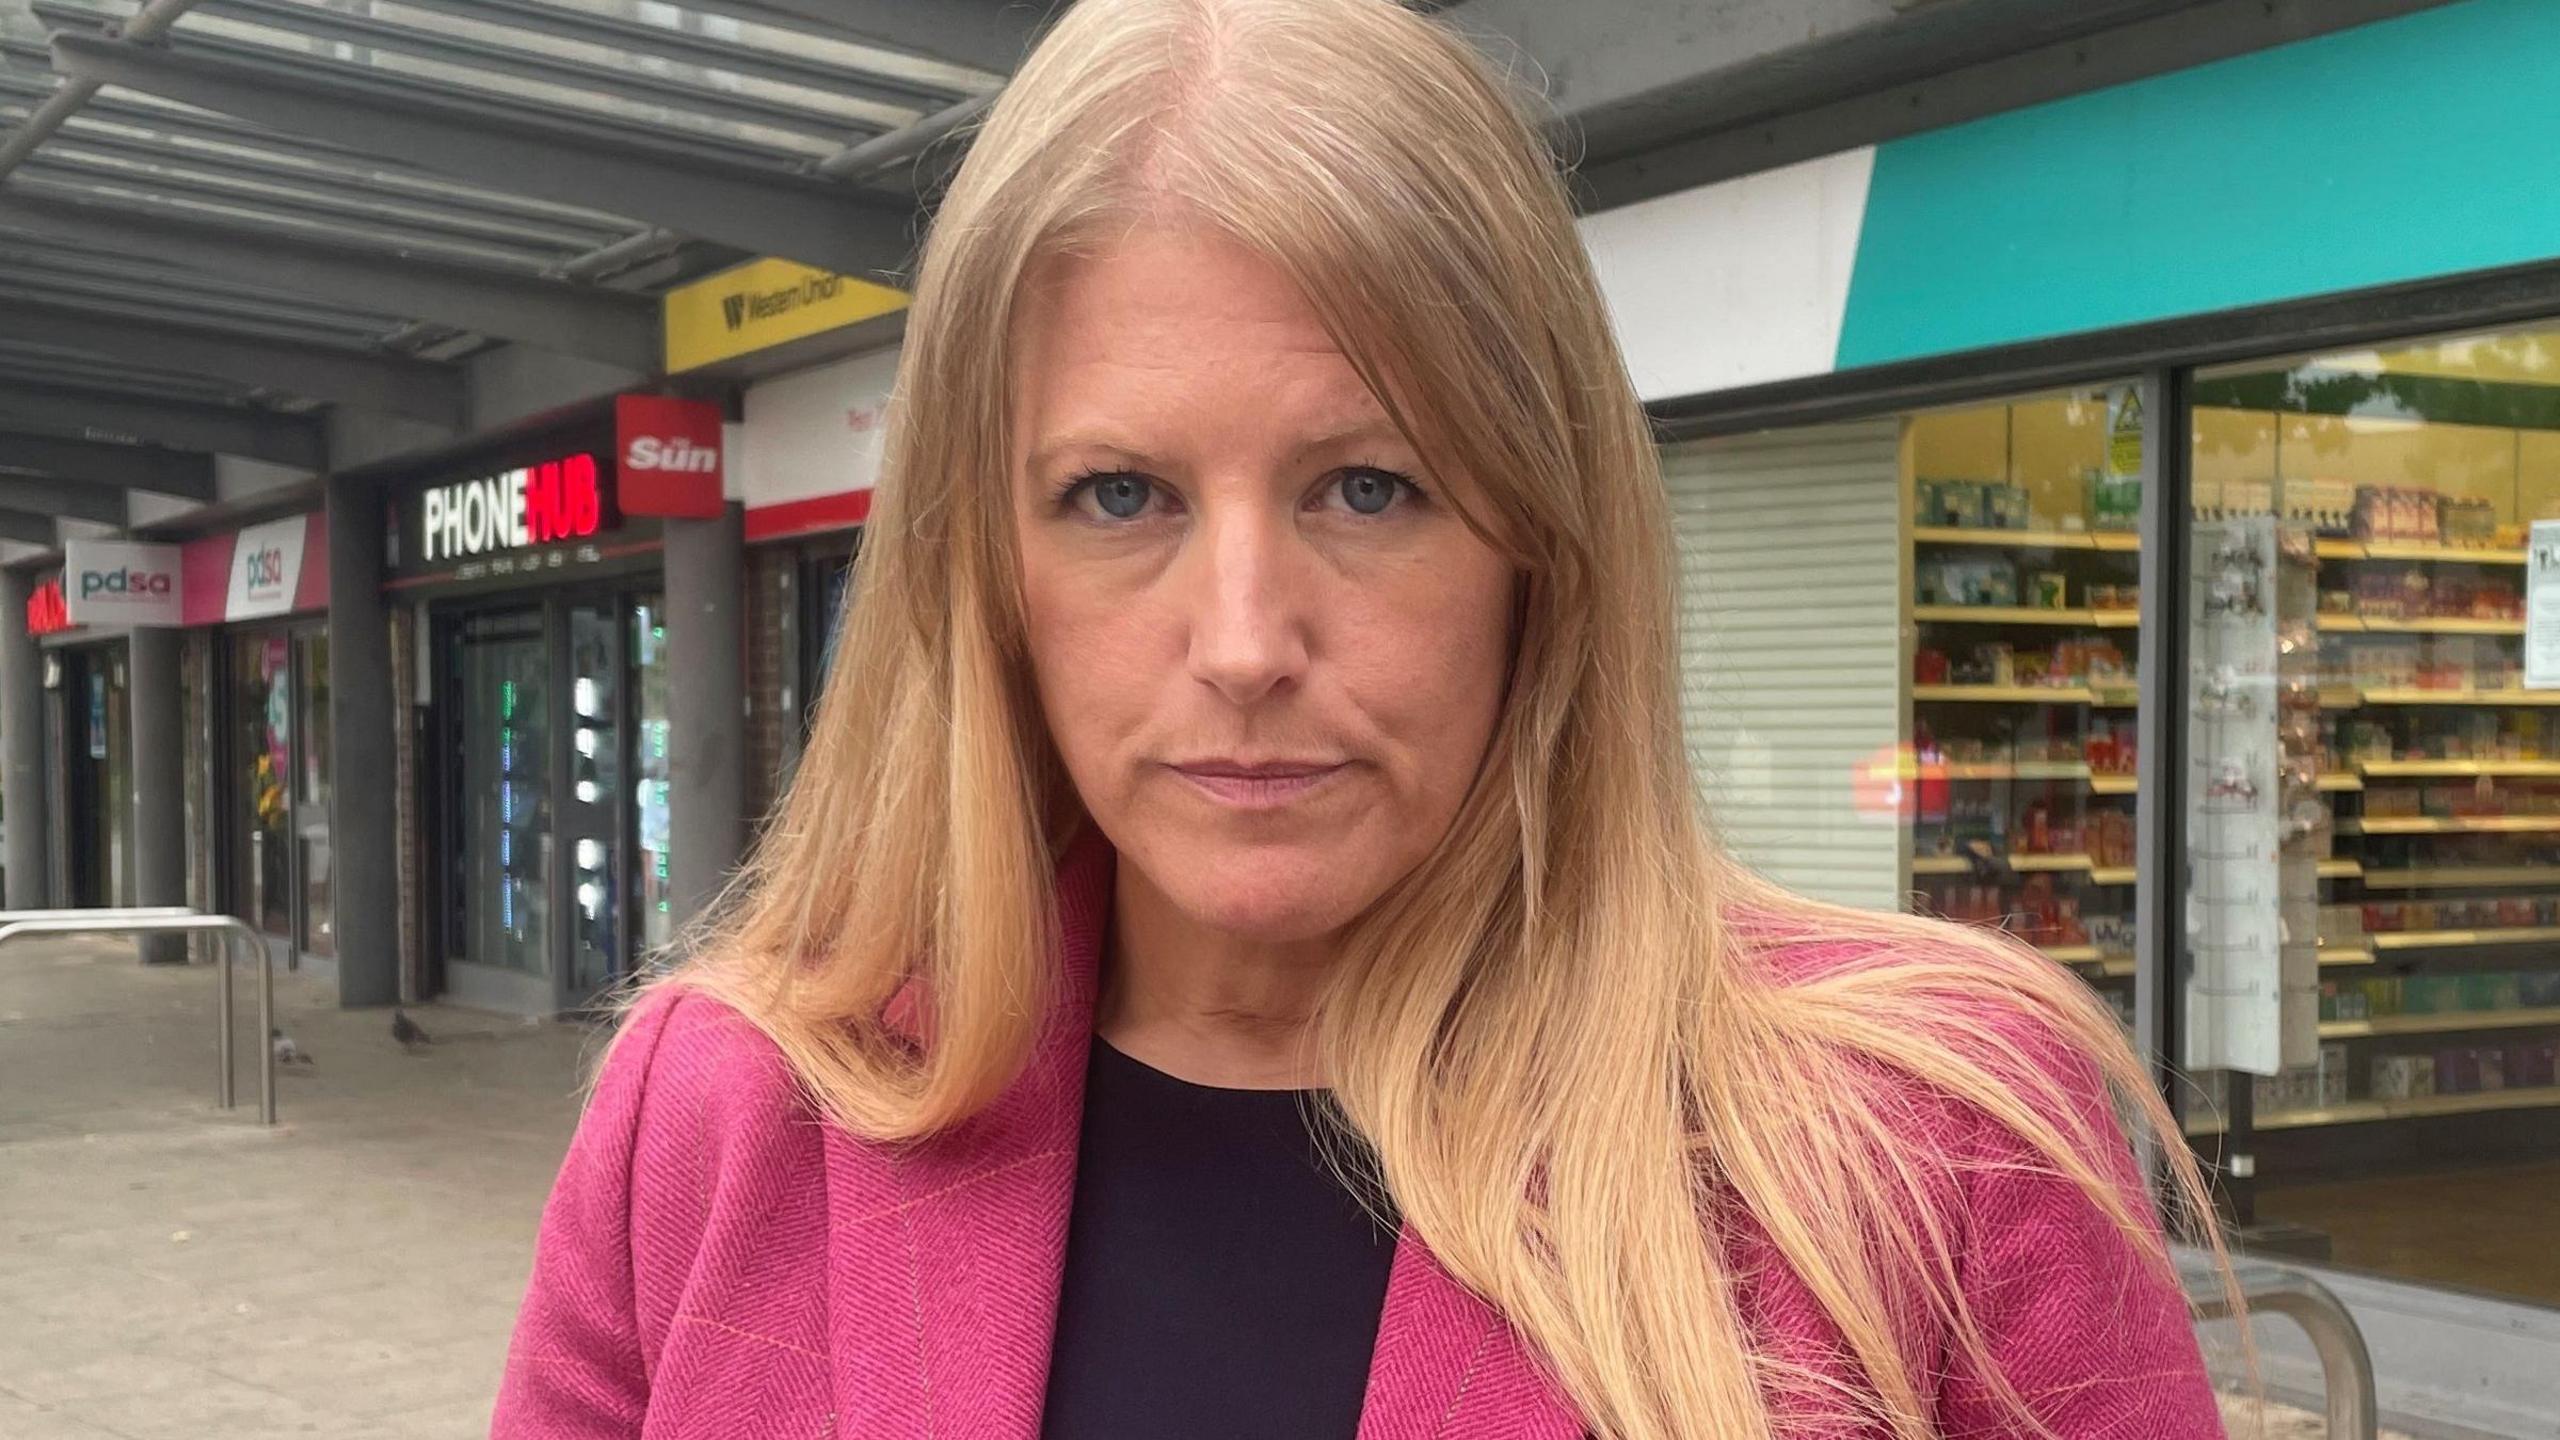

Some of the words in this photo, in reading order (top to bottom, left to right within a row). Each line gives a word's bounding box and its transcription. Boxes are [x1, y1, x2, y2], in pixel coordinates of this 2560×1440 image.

[749, 286, 800, 320] Western
[801, 274, 844, 305] Union
[625, 434, 717, 473] Sun
[81, 566, 171, 599] pdsa
[247, 543, 282, 589] pdsa
